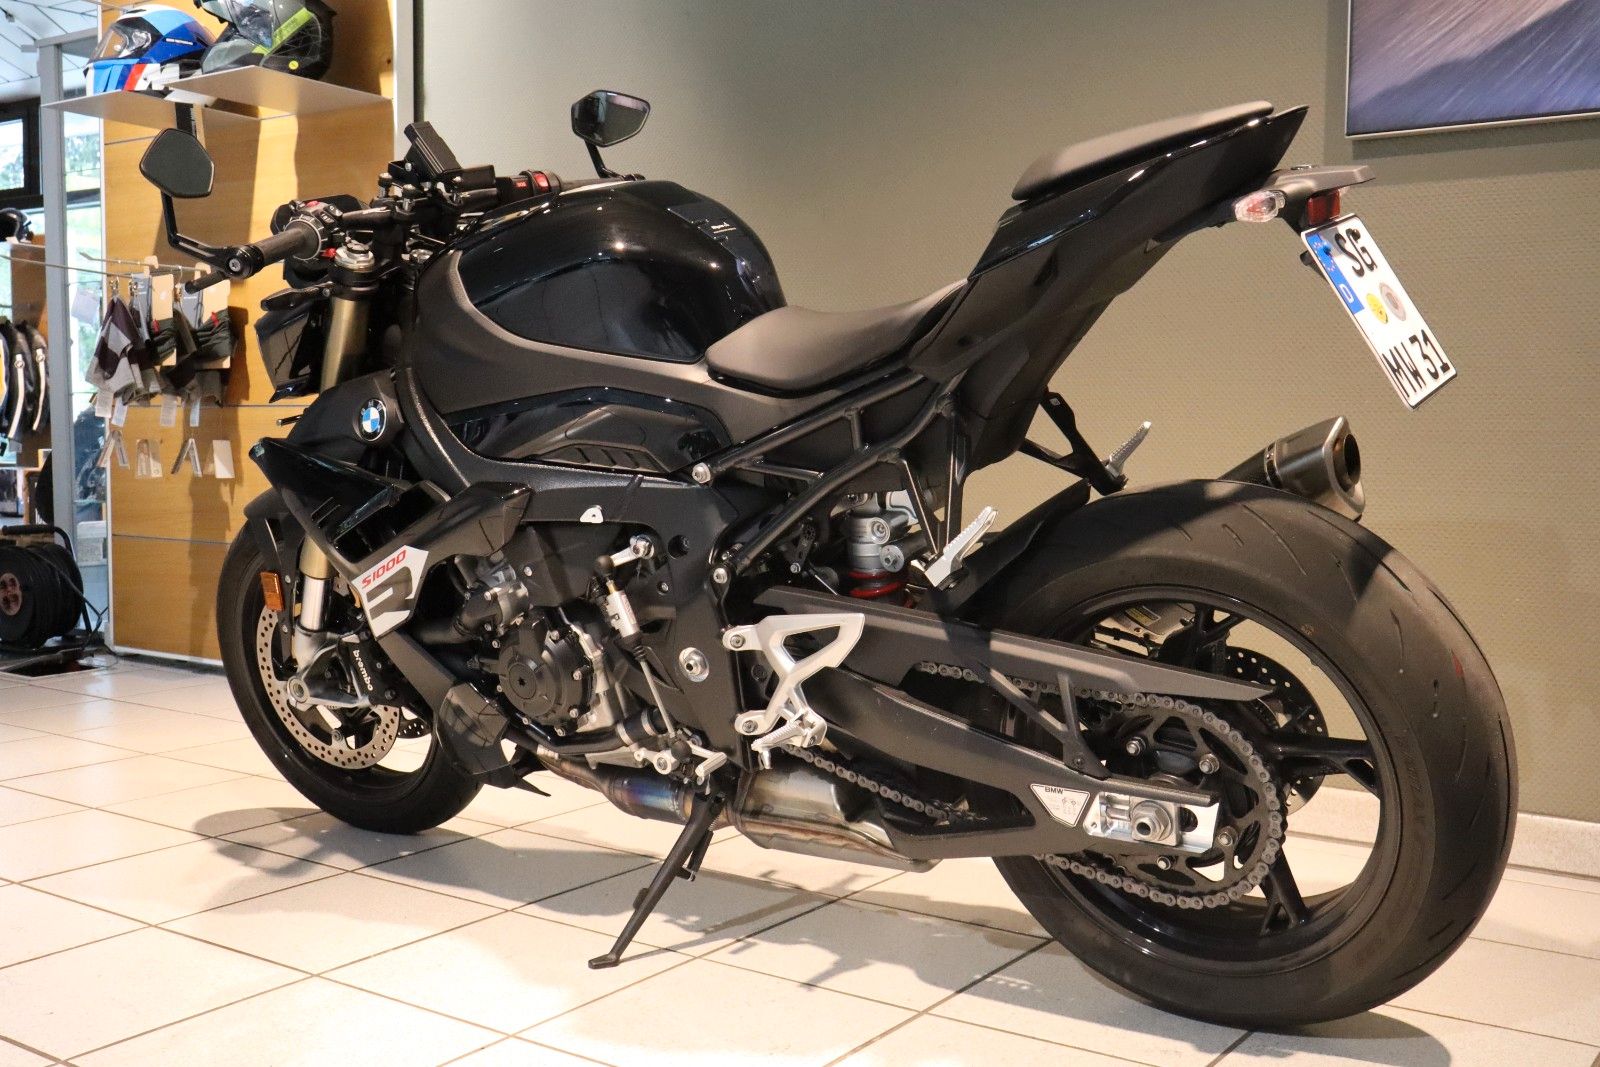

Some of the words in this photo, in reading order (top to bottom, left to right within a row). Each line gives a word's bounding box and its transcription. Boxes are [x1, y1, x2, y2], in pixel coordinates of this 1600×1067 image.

[1334, 228, 1377, 277] SG
[1339, 284, 1353, 303] D
[1382, 341, 1427, 398] MW
[1408, 329, 1451, 380] 31
[361, 549, 407, 589] S1000
[353, 649, 373, 691] brembo
